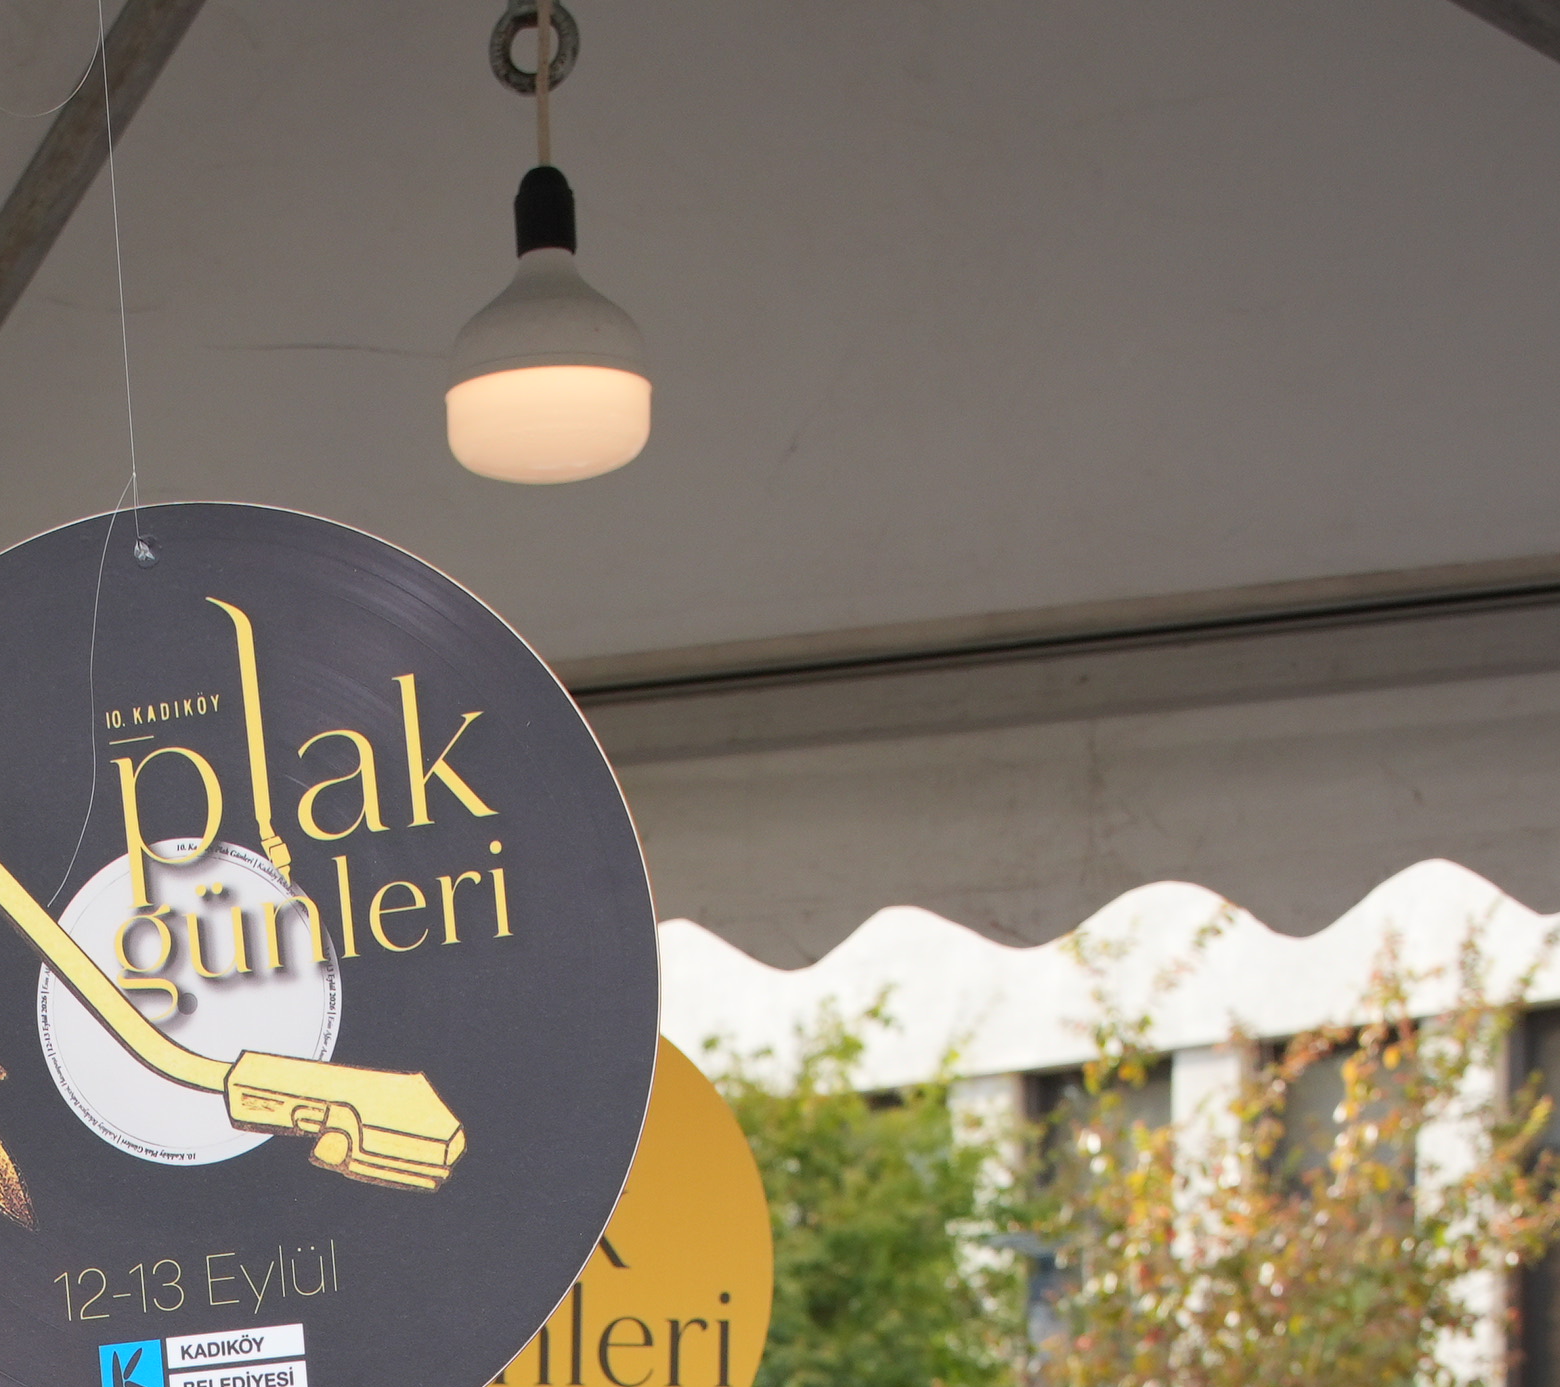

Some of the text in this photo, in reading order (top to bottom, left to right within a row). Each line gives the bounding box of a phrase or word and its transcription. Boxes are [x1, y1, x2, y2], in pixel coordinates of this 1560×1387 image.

[110, 596, 499, 909] plak
[133, 693, 220, 725] KADIKÖY
[114, 840, 514, 1023] günleri
[54, 1239, 338, 1321] 12-13 Eylül
[180, 1335, 265, 1361] KADIKÖY
[493, 1281, 732, 1387] leri
